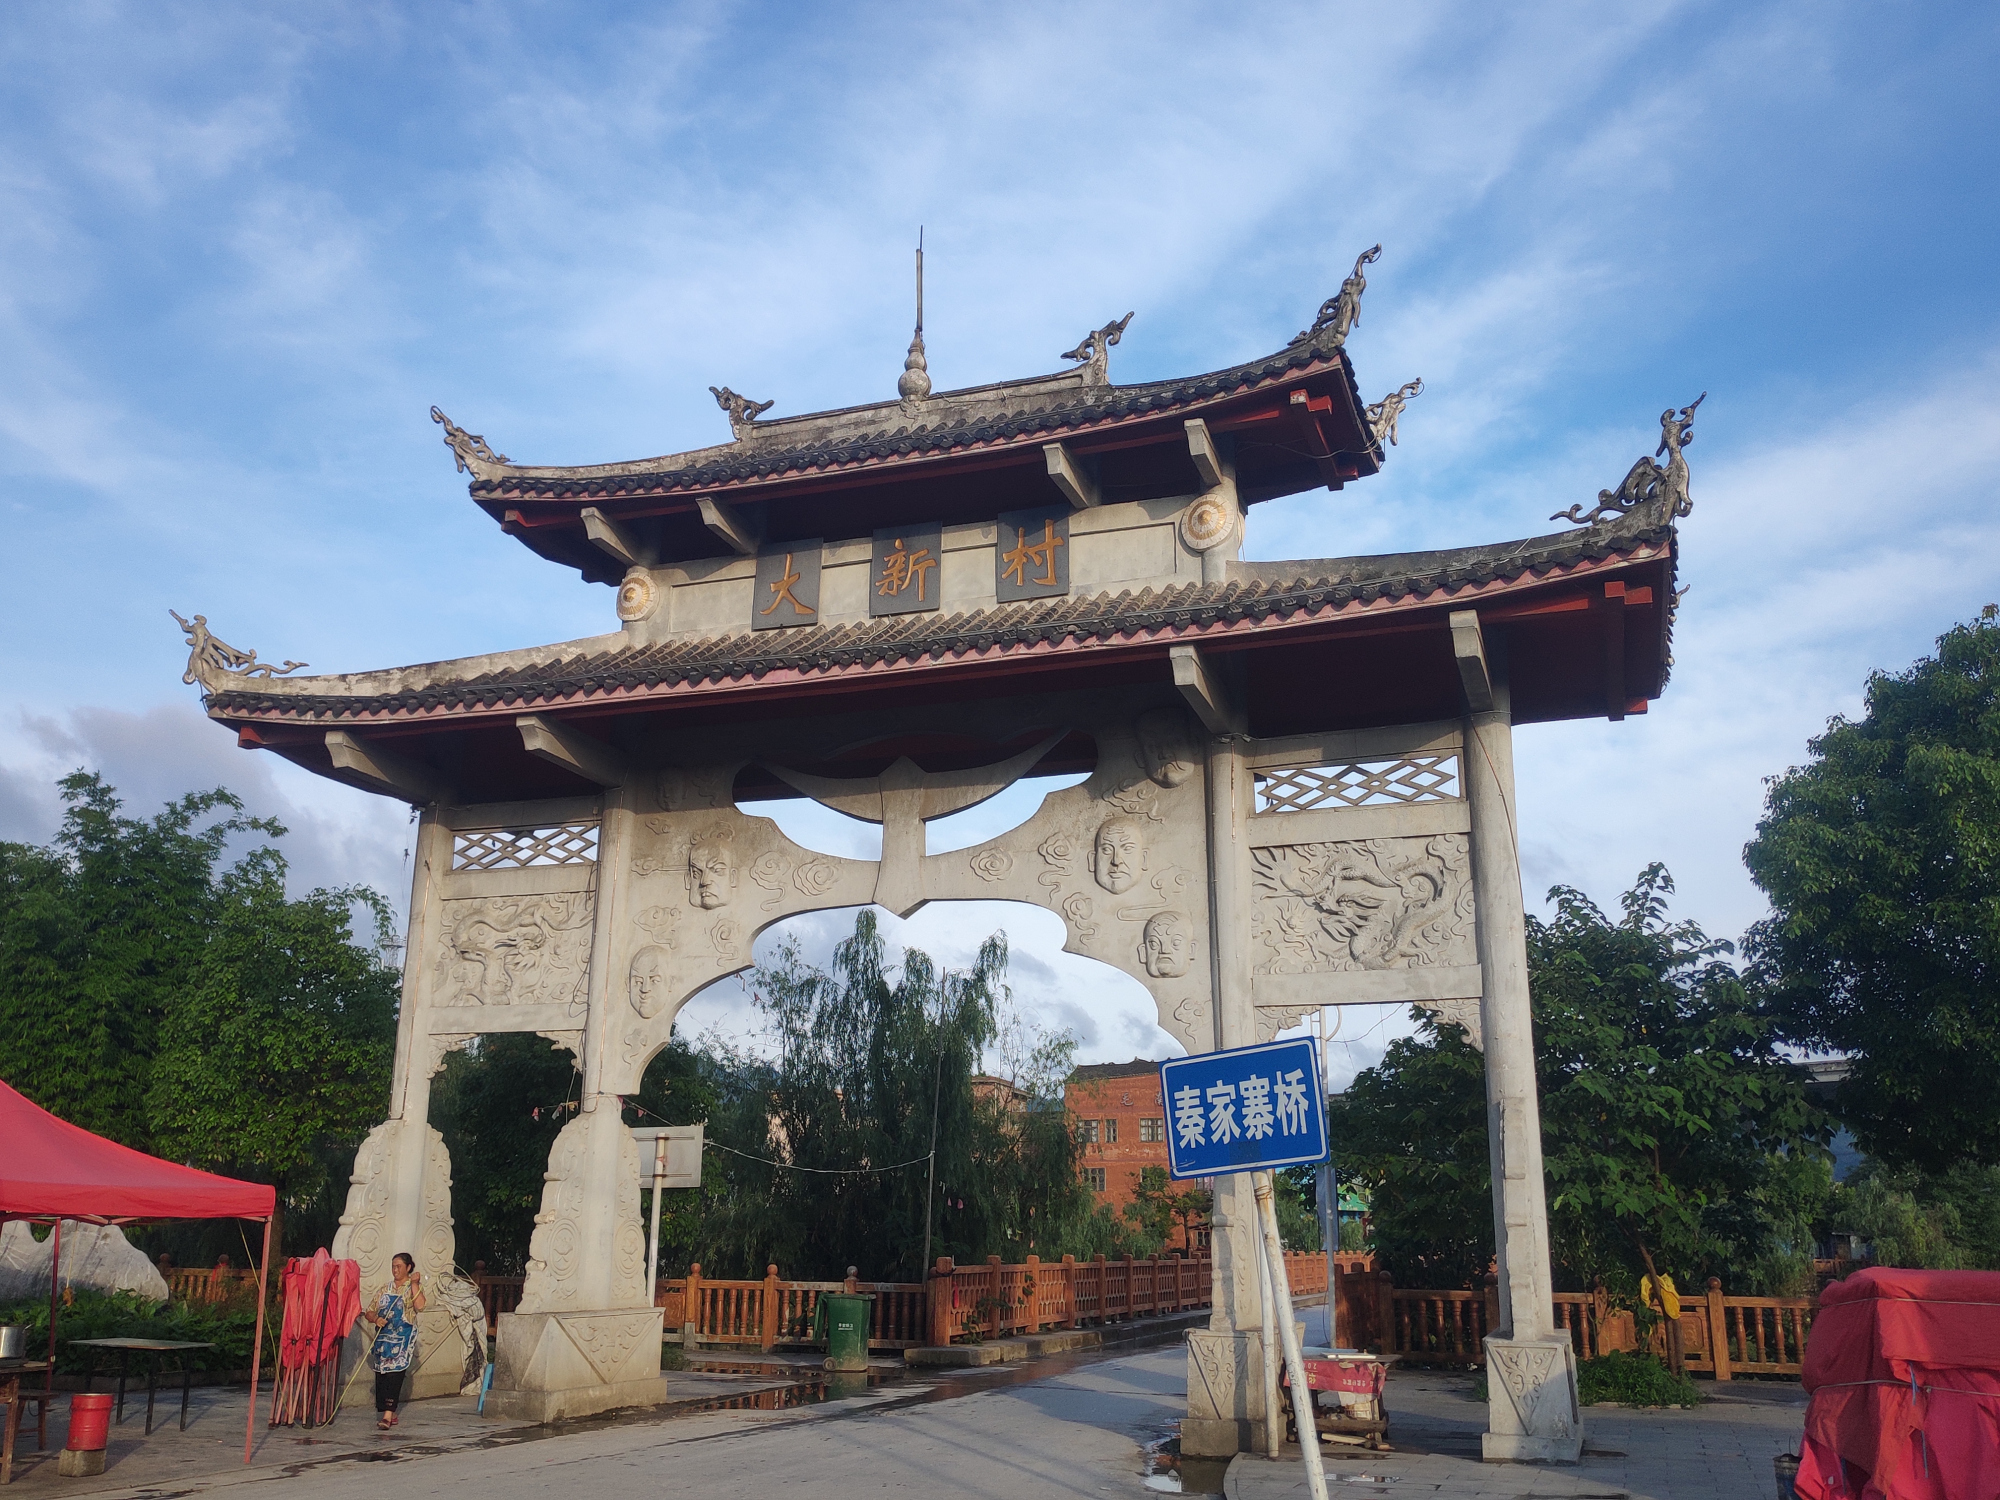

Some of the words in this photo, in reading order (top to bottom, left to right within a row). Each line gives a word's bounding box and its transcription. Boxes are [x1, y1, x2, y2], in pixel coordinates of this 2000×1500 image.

[760, 519, 1064, 615] 大新村
[1173, 1068, 1309, 1149] 秦家寨桥
